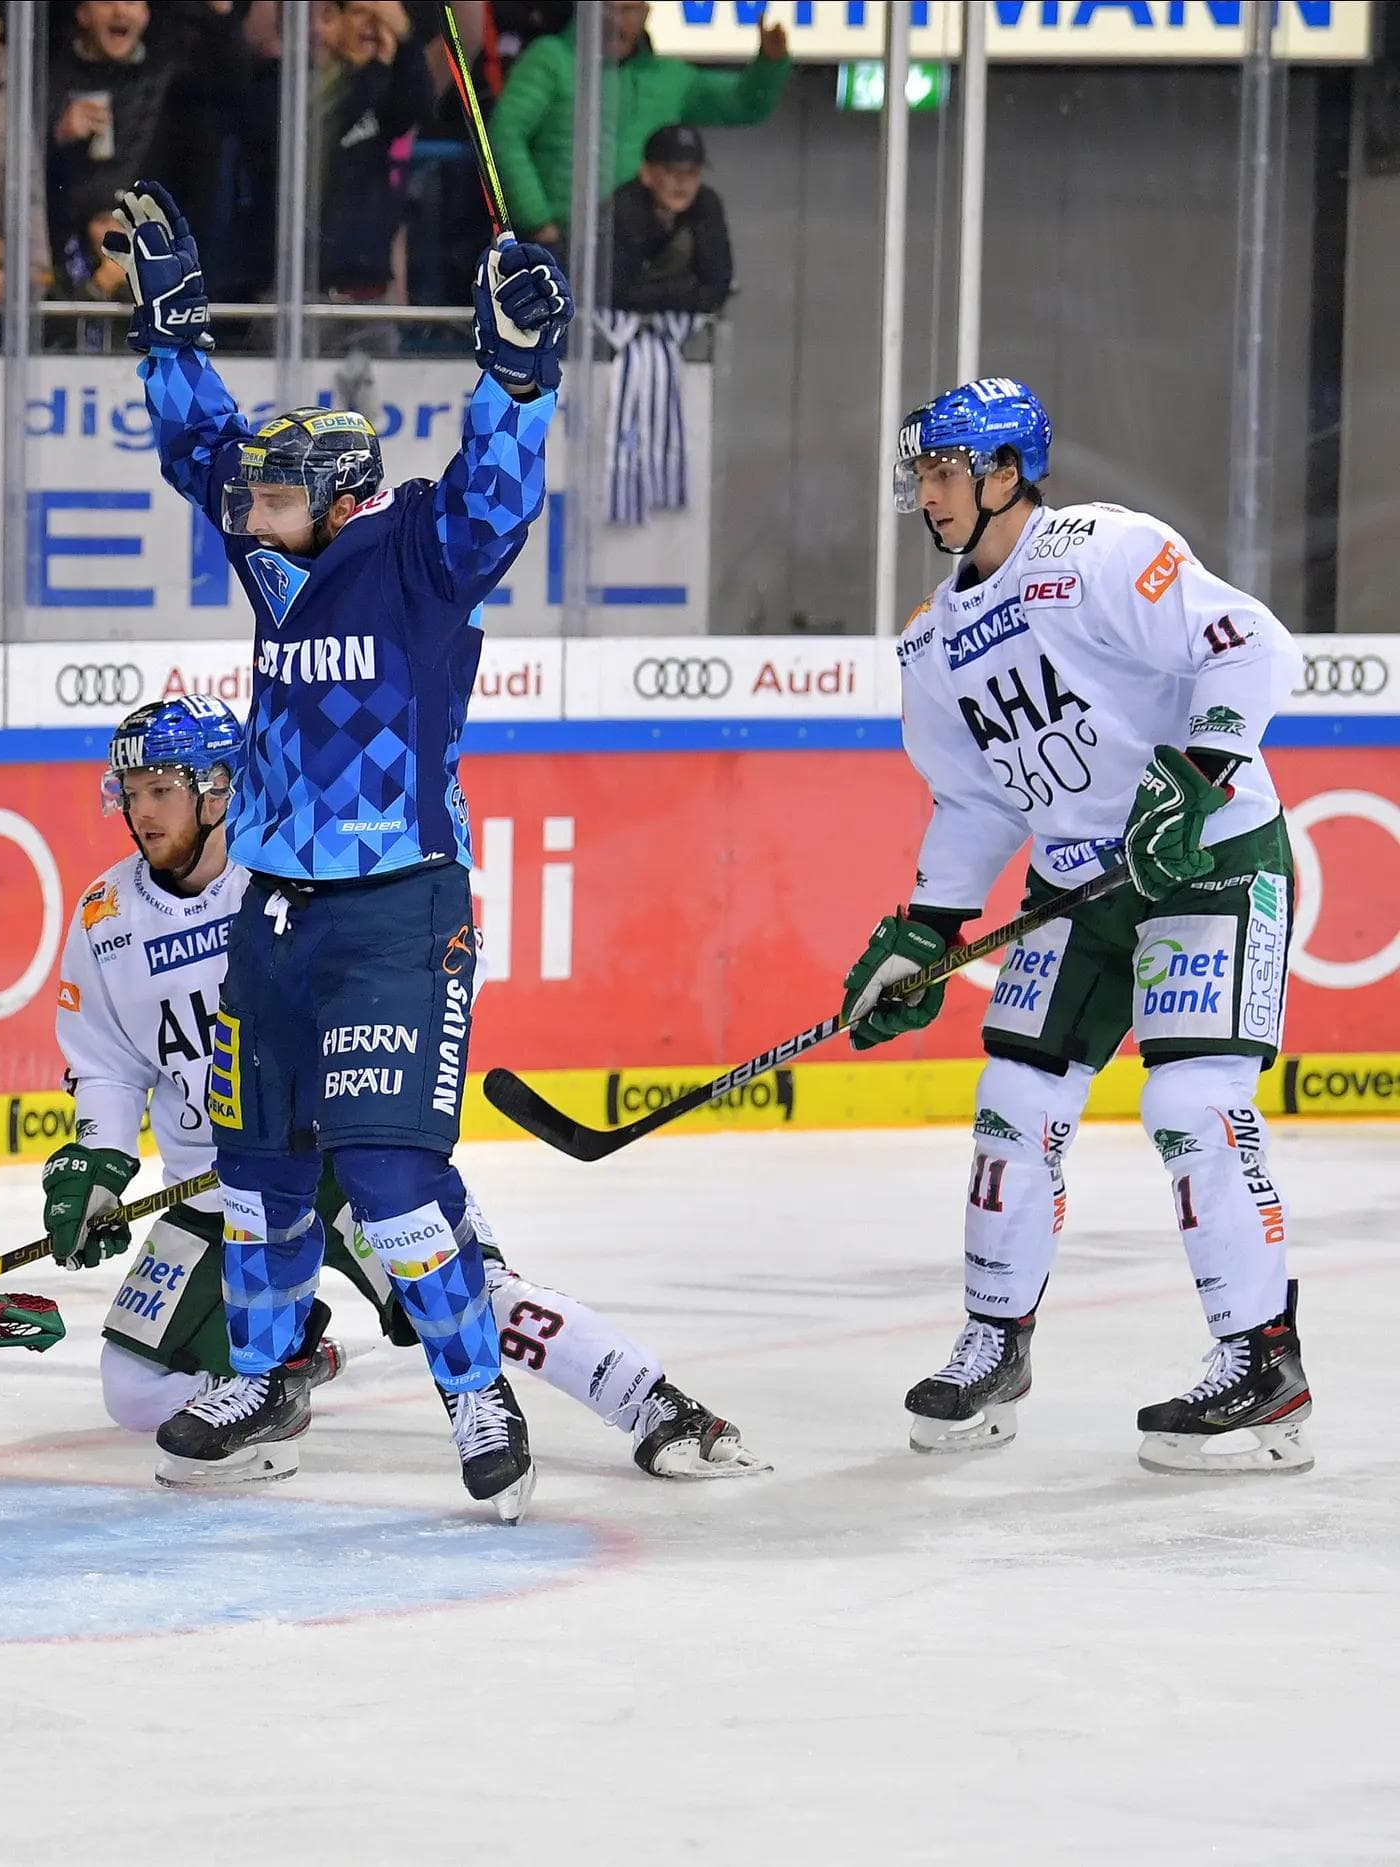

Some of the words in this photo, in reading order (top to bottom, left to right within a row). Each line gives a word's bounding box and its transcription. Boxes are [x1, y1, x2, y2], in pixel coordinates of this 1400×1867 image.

[968, 378, 1021, 402] LEW
[312, 414, 366, 431] EDEKA
[1037, 518, 1097, 538] AHA
[1024, 576, 1076, 602] DEL
[896, 627, 936, 657] ehner
[945, 602, 1028, 663] HAIMER
[1203, 614, 1247, 655] 11
[161, 666, 251, 702] Audi
[471, 661, 543, 697] udi
[752, 659, 857, 697] Audi
[958, 653, 1091, 751] AHA
[110, 735, 145, 769] LEW
[342, 820, 402, 832] BAUER
[1190, 874, 1255, 891] BAUER
[150, 920, 234, 969] HAIME
[1244, 918, 1277, 1038] Greif
[994, 979, 1042, 1012] ank
[1144, 982, 1222, 1016] bank
[157, 982, 223, 1066] AH
[322, 1024, 419, 1057] HERRN
[711, 1027, 818, 1098] BAUER
[324, 1066, 404, 1099] BRÄU
[71, 1159, 88, 1173] 93
[969, 1151, 1008, 1214] 11
[136, 1256, 186, 1291] net
[114, 1288, 167, 1322] ank
[499, 1300, 565, 1371] 93
